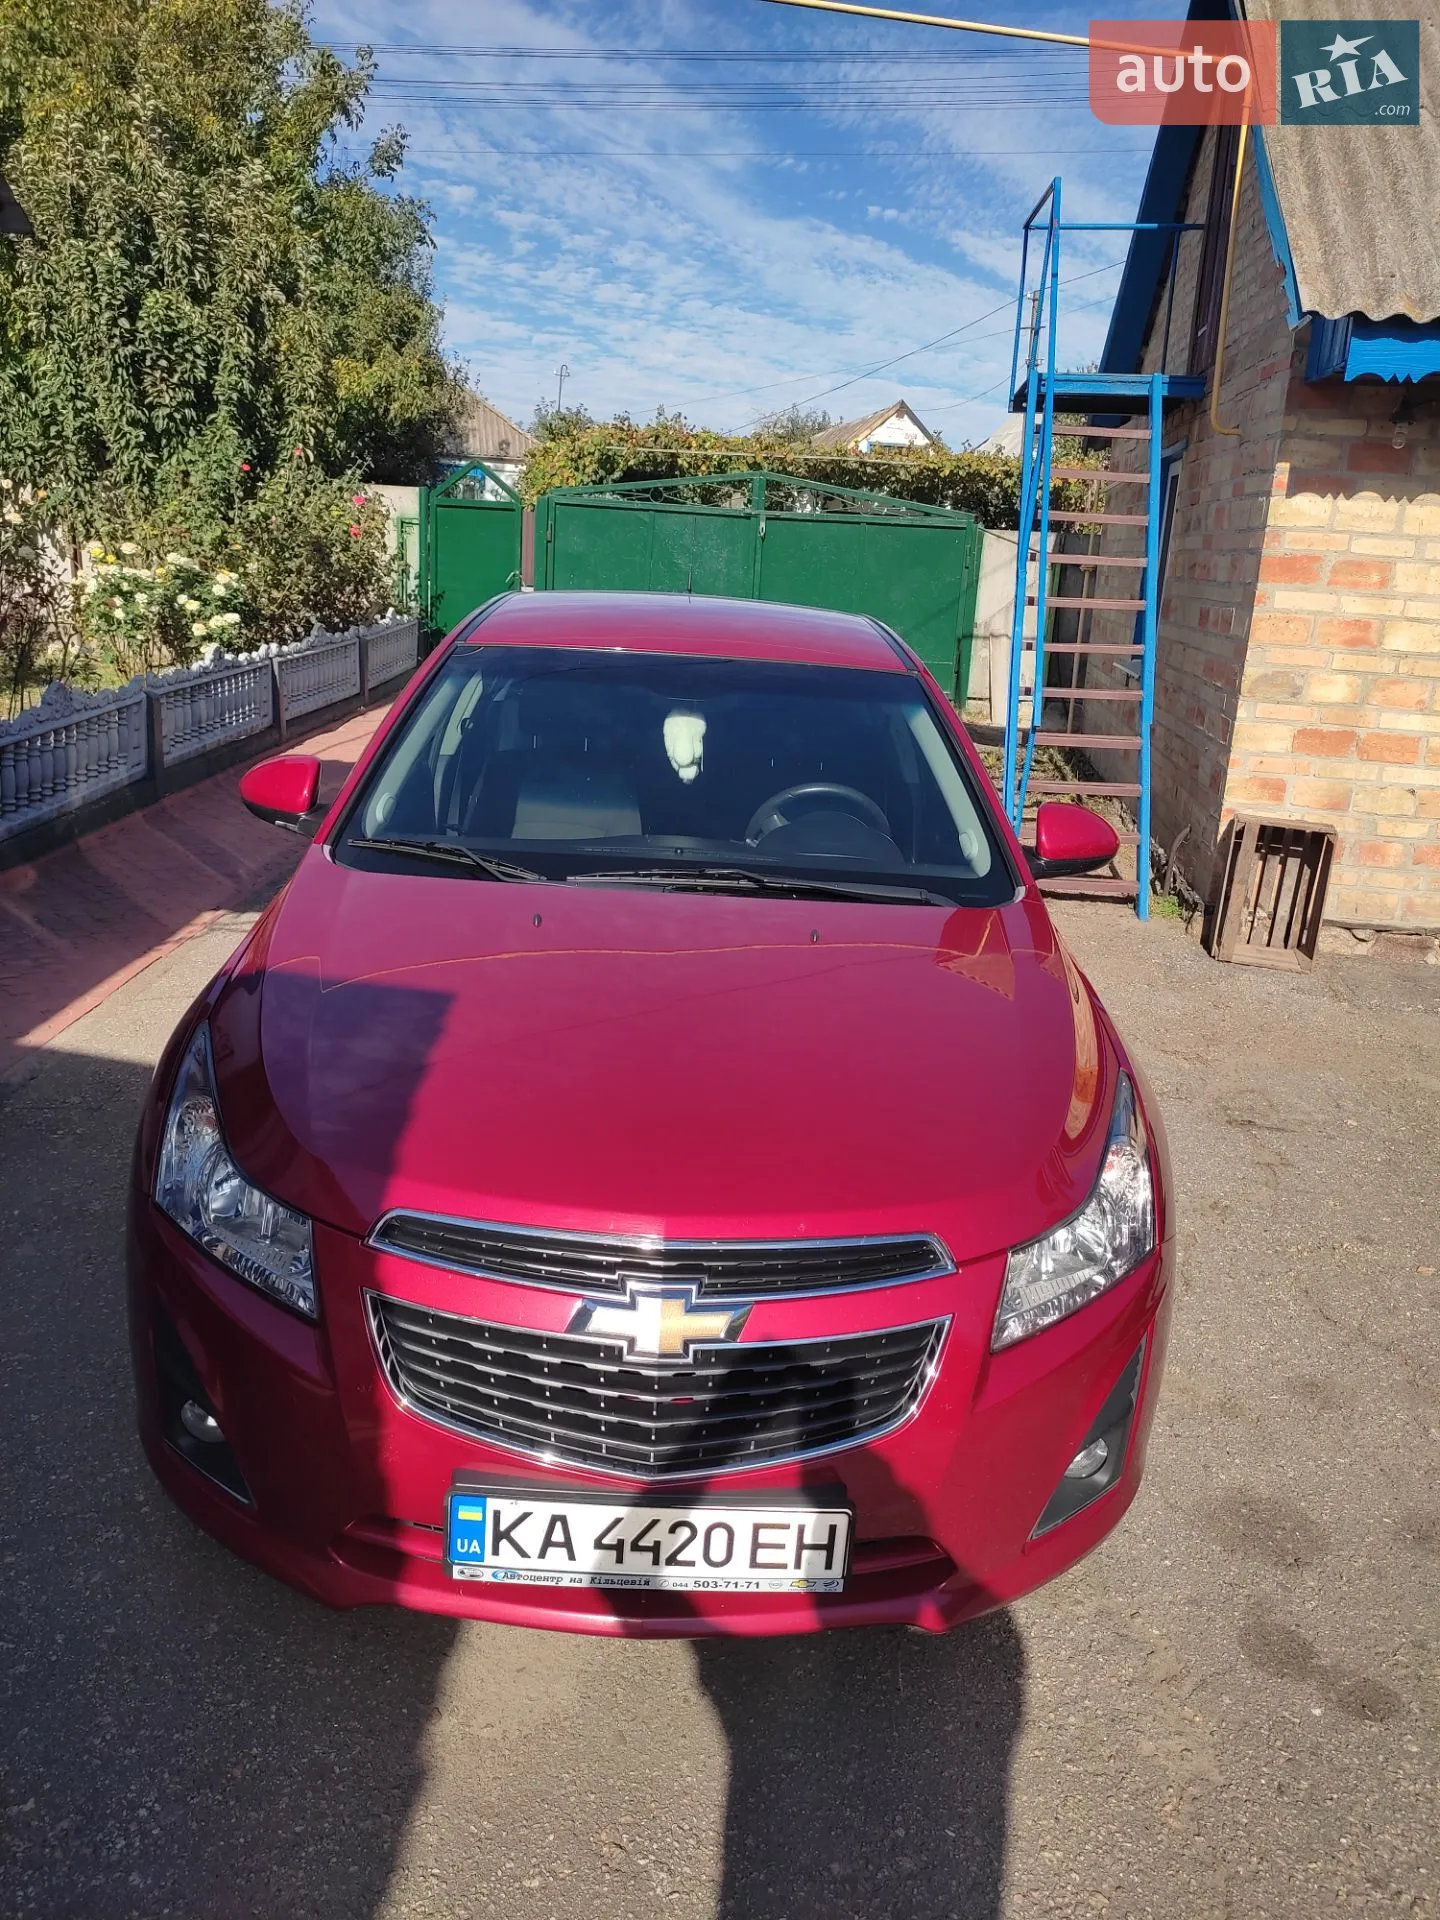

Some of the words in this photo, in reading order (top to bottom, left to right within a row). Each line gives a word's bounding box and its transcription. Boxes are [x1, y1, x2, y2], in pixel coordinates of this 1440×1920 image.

[457, 1538, 481, 1554] UA
[491, 1509, 577, 1561] KA
[593, 1517, 735, 1568] 4420
[749, 1523, 837, 1570] EH
[502, 1571, 563, 1585] Автоцентр
[569, 1576, 583, 1584] на
[590, 1575, 651, 1586] Кільцевій
[693, 1580, 760, 1589] 503-71-71
